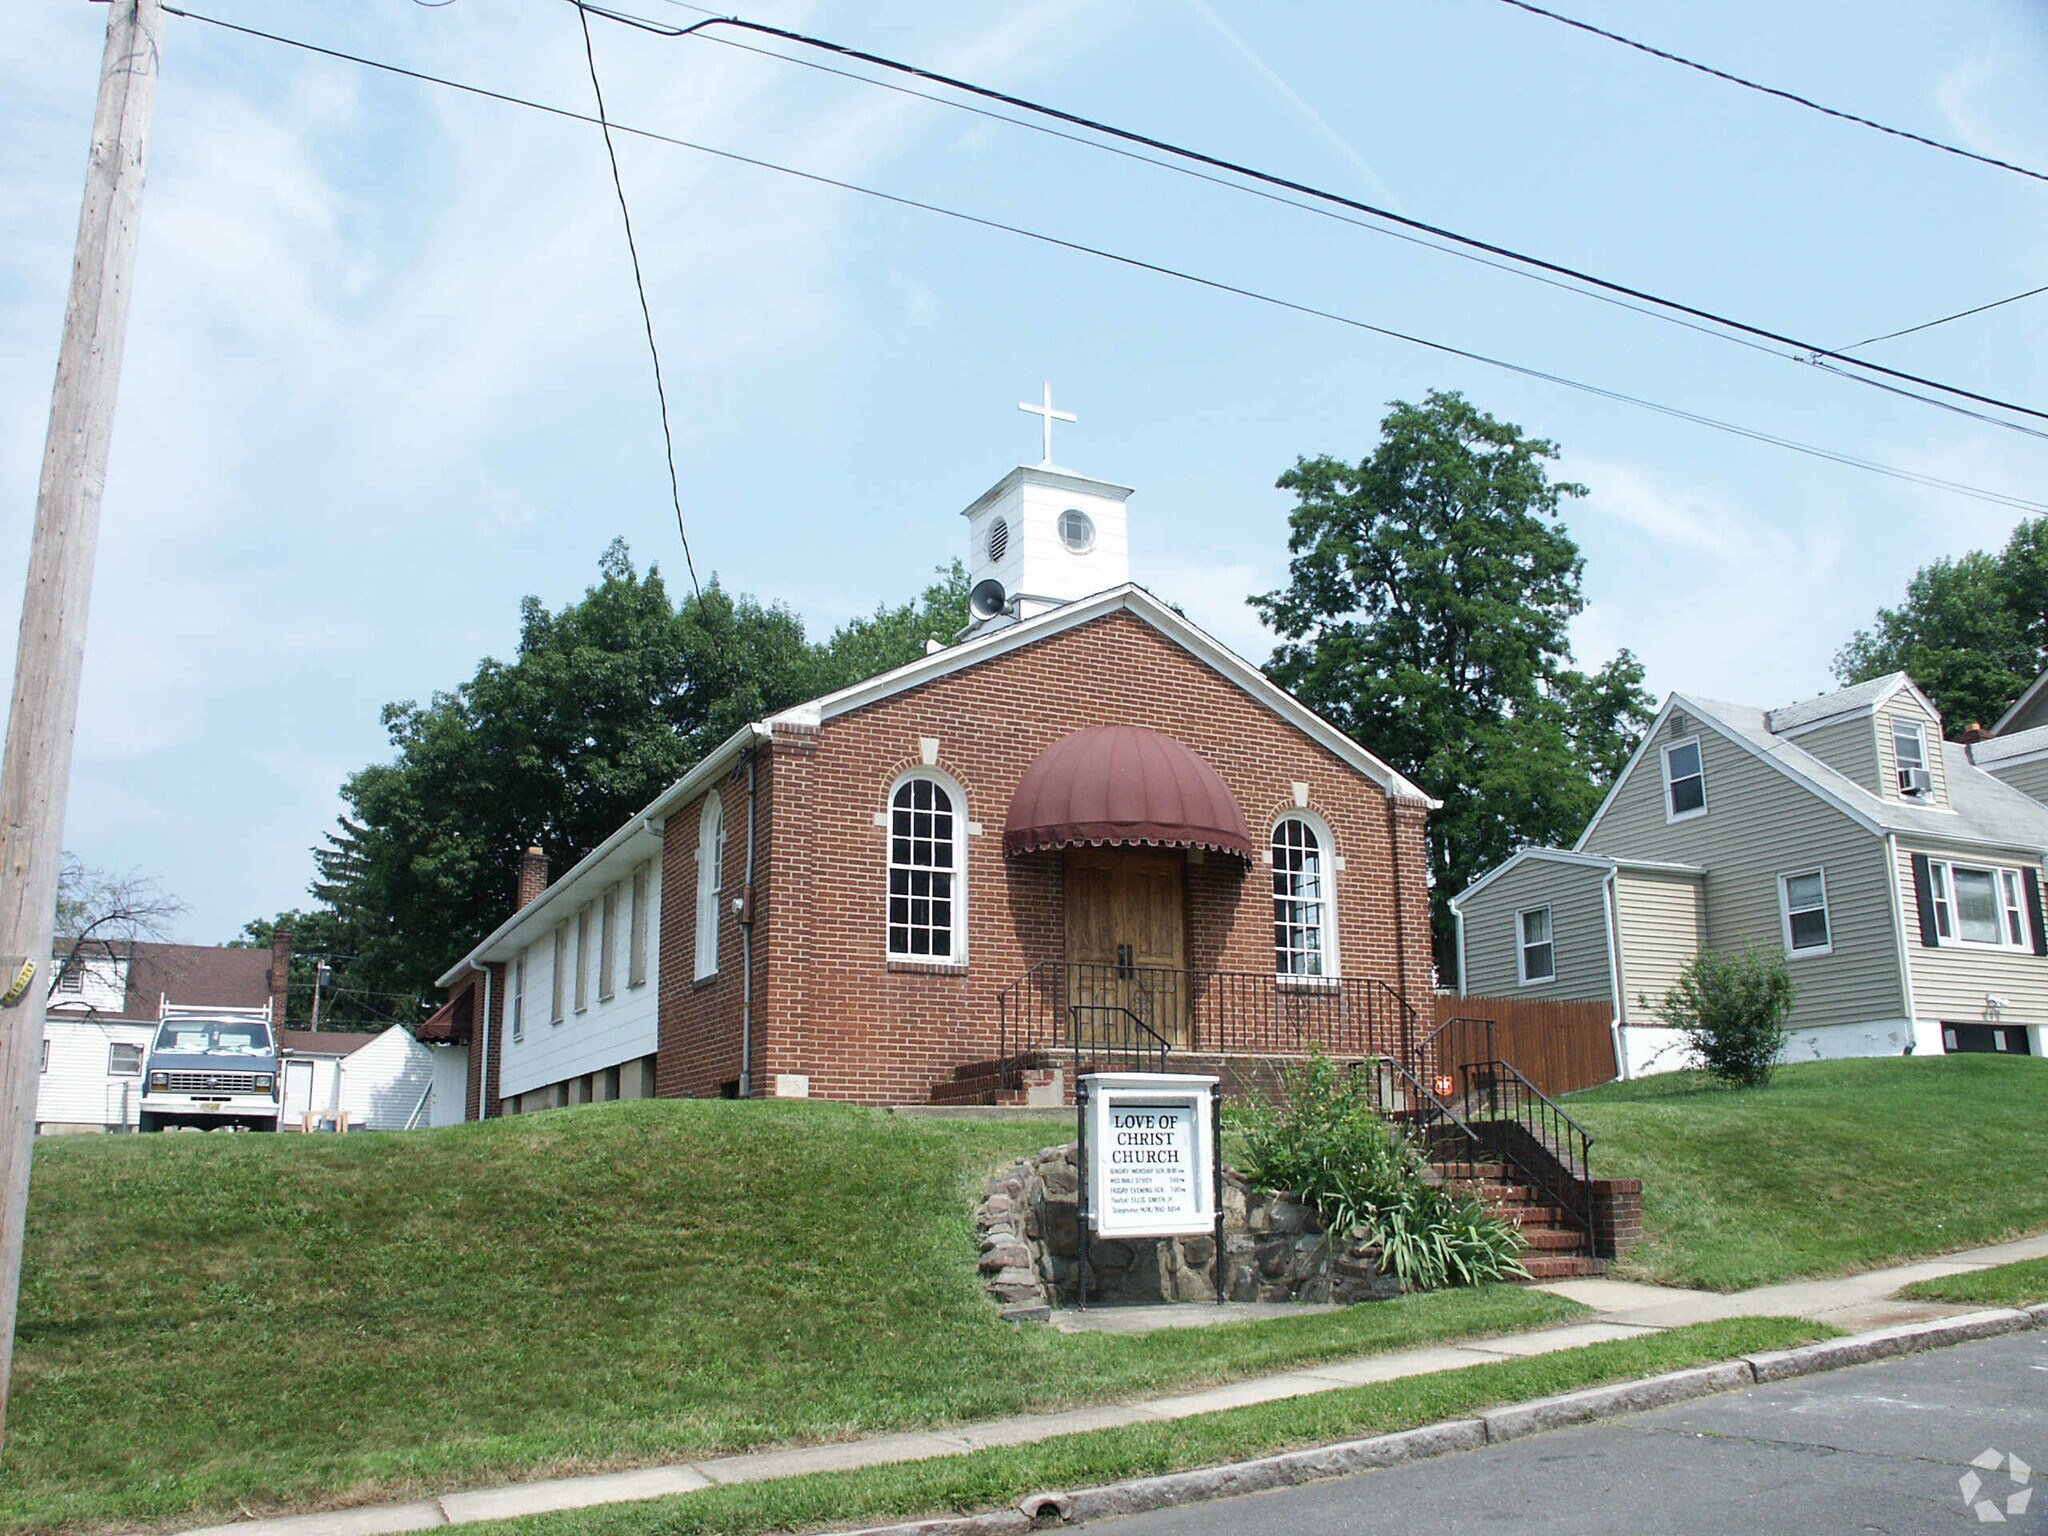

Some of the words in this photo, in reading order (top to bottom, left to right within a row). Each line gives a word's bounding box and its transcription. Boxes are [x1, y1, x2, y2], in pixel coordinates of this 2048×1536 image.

[1114, 1115, 1155, 1129] LOVE
[1158, 1115, 1178, 1129] OF
[1117, 1132, 1175, 1146] CHRIST
[1112, 1150, 1180, 1164] CHURCH
